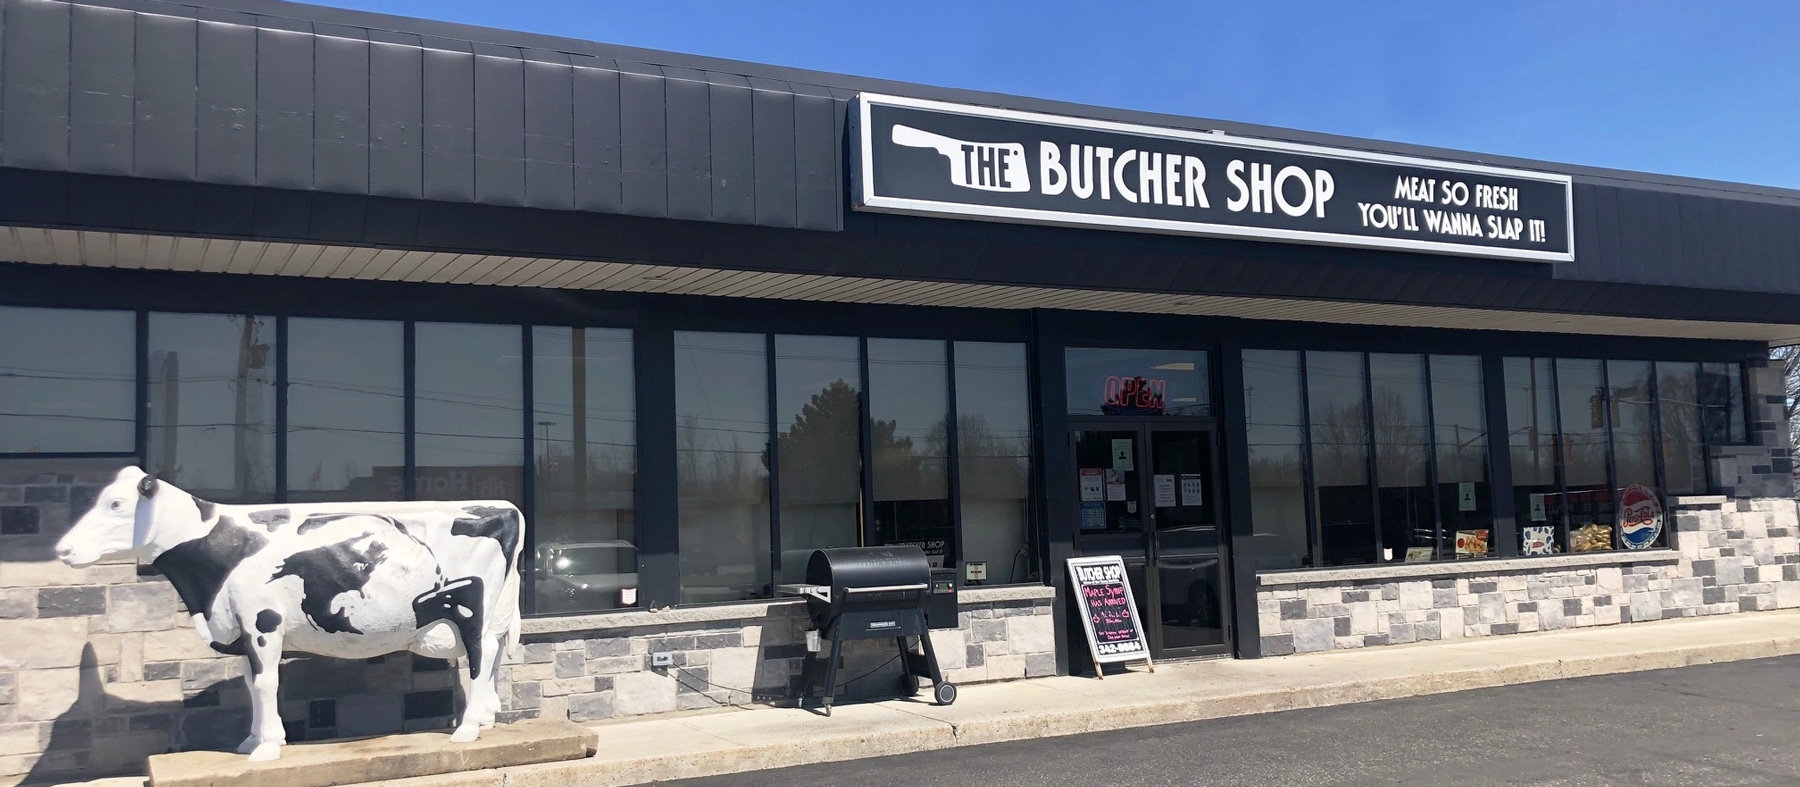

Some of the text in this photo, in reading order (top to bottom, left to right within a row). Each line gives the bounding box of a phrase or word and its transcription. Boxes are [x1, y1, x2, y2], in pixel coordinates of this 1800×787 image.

[961, 140, 1335, 218] THE BUTCHER SHOP
[1394, 175, 1519, 211] MEAT SO FRESH
[1358, 202, 1546, 243] YOU'LL WANNA SLAP IT!
[1104, 376, 1166, 409] OPEN
[1075, 565, 1121, 581] BUTCHER SHOP
